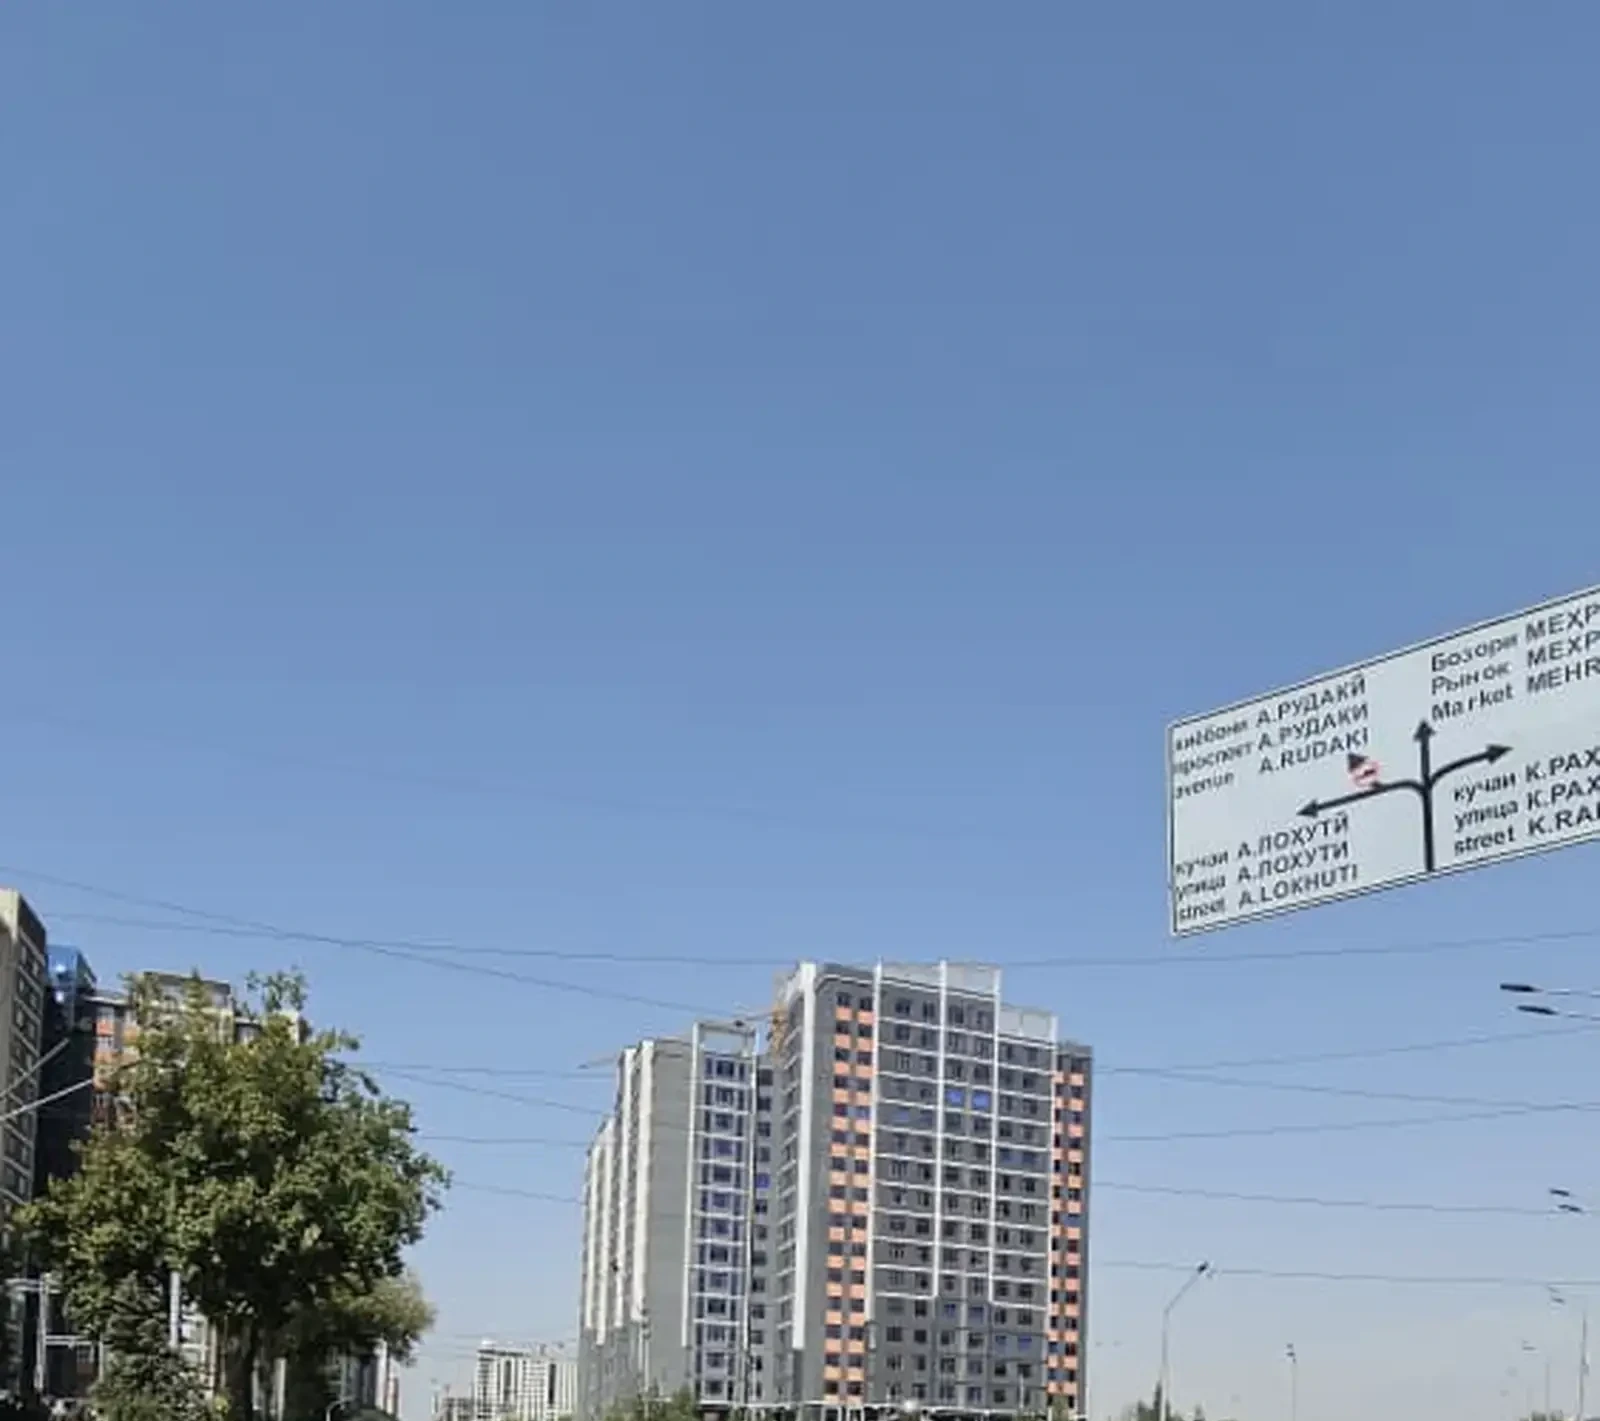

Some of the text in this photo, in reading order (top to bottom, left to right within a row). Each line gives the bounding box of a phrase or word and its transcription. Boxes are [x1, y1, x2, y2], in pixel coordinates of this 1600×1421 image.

[1432, 662, 1511, 696] Рынок
[1432, 683, 1513, 721] Market
[1257, 703, 1369, 750] А.РУДАКИ
[1259, 727, 1369, 774] A.RUDAKI
[1454, 801, 1518, 833] улица
[1454, 802, 1600, 856] street K.RA
[1238, 841, 1349, 883] А.ЛОХУТИ
[1178, 864, 1358, 921] street A.LOKHUTI
